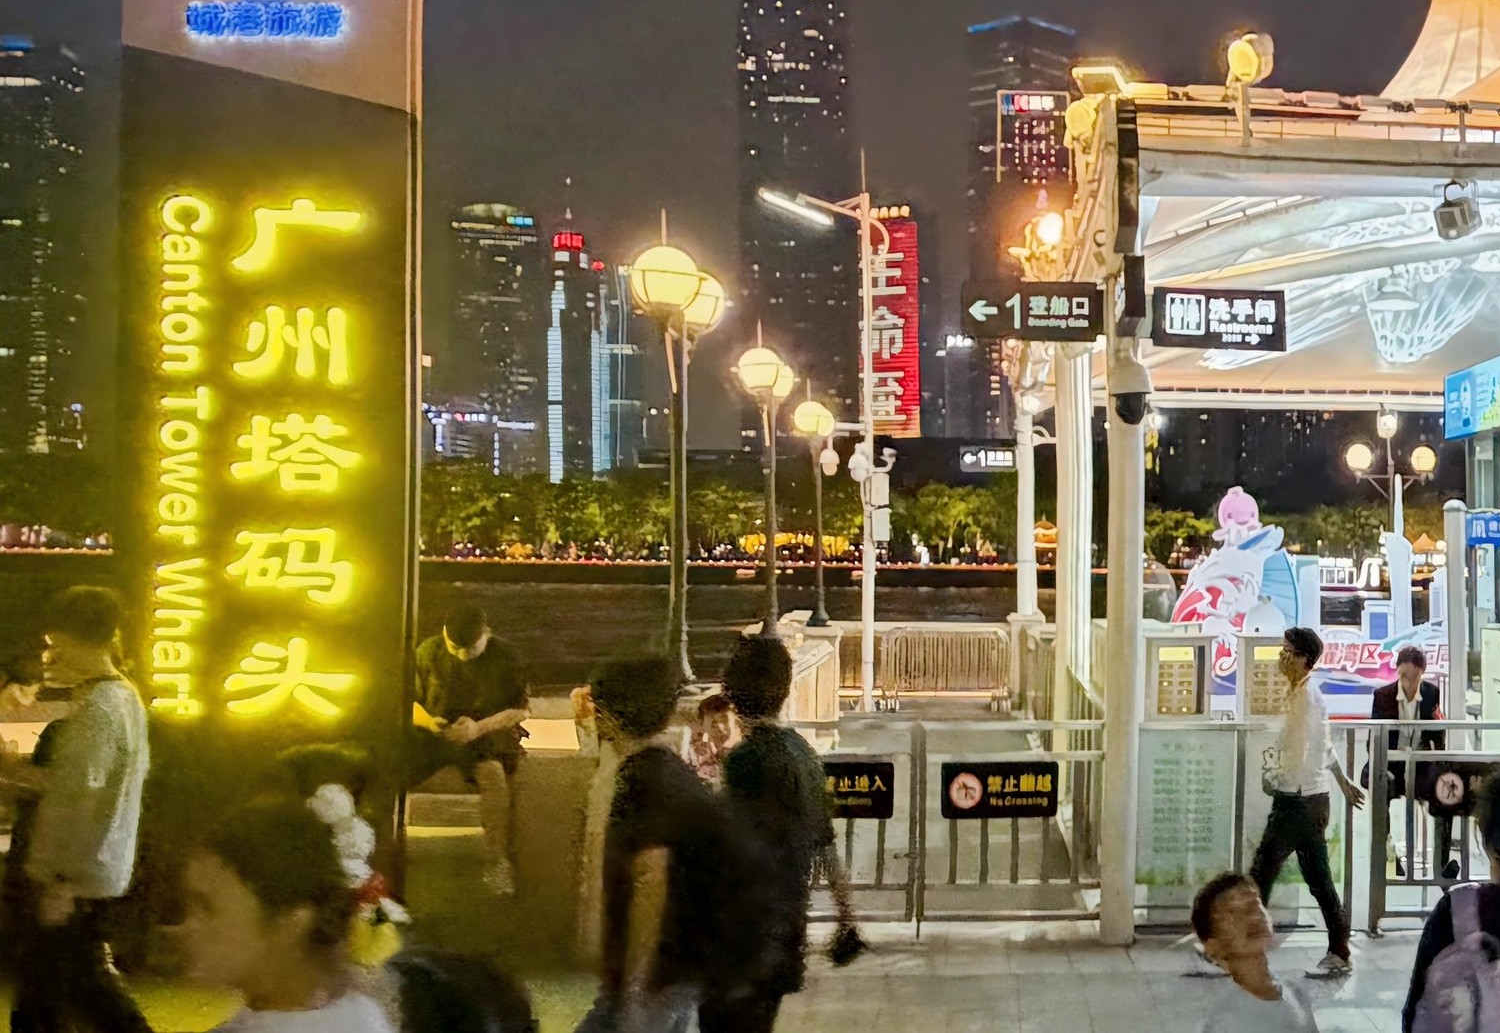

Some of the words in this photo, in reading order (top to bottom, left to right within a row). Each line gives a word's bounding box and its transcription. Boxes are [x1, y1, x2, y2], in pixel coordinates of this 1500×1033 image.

[160, 194, 214, 372] Canton
[1005, 292, 1021, 329] 1
[1029, 295, 1089, 315] 登船口
[1208, 298, 1276, 322] 洗手间
[157, 386, 210, 546] Tower
[225, 198, 366, 717] 广州塔码头
[149, 559, 206, 717] Wharf
